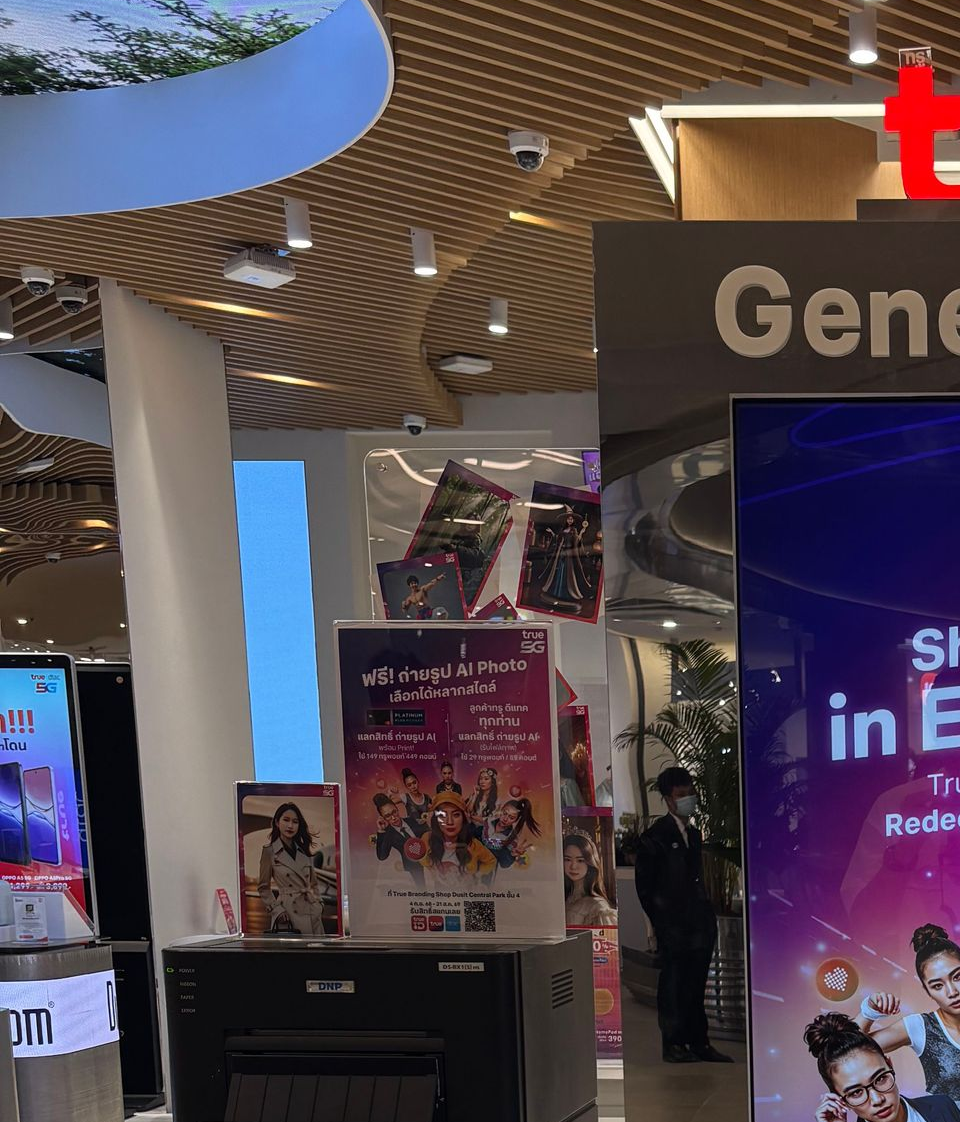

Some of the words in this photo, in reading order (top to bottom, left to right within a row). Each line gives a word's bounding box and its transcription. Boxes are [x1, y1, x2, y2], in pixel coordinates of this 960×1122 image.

[522, 630, 545, 640] true
[520, 640, 545, 654] 5G
[362, 666, 394, 687] ฟรี!
[398, 663, 452, 685] ถ่ายรูป
[456, 662, 473, 678] AI
[477, 658, 528, 674] Photo
[36, 682, 57, 693] 5G
[389, 679, 497, 703] เลือกได้หลากสไตล์
[479, 714, 520, 730] ทุกท่าน
[829, 692, 896, 761] in
[435, 891, 452, 899] Shop
[319, 982, 343, 991] DNP
